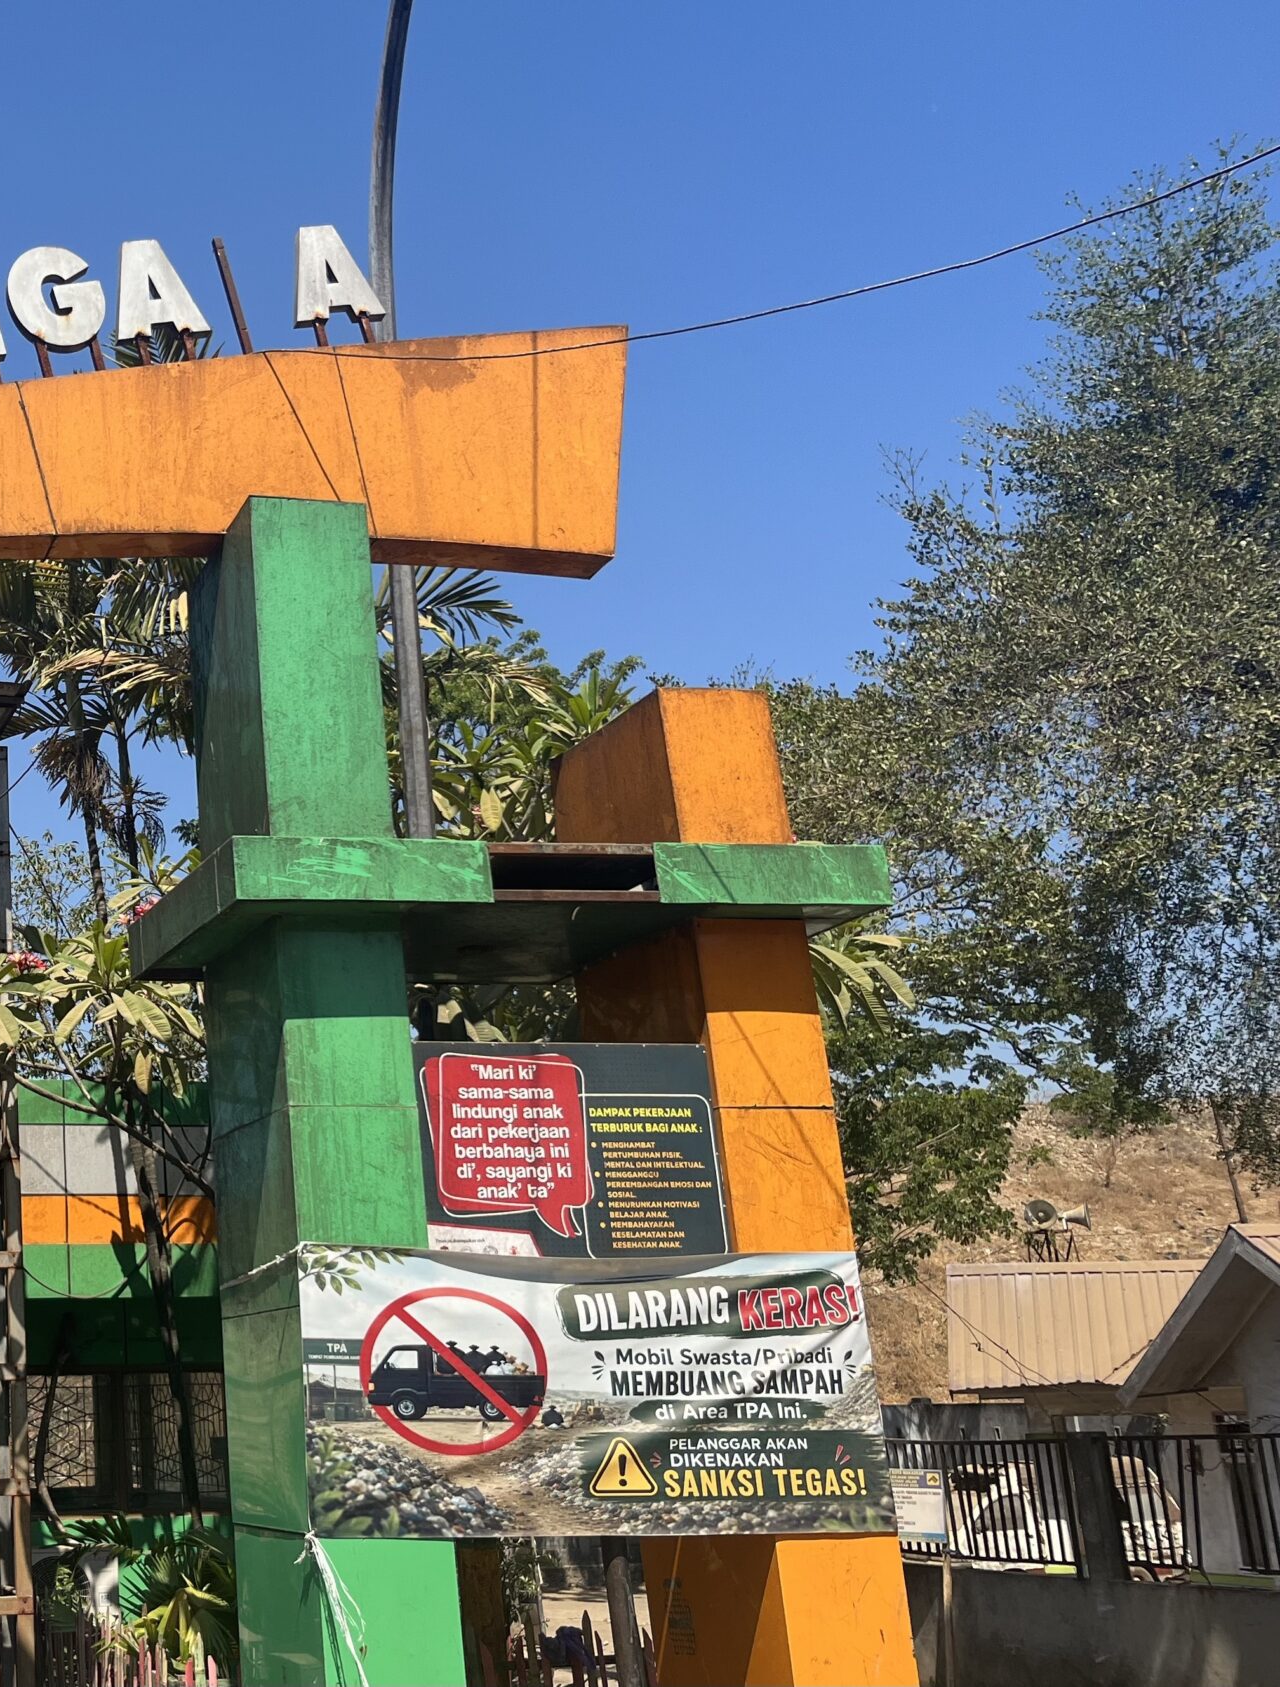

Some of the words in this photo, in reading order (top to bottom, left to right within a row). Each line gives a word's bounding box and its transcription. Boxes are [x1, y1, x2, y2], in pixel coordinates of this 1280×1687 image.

[458, 1086, 554, 1100] sama-sama
[452, 1103, 517, 1123] lindungi
[521, 1104, 563, 1119] anak
[589, 1108, 631, 1118] DAMPAK
[633, 1108, 692, 1118] PEKERJAAN
[450, 1123, 483, 1139] dari
[487, 1124, 570, 1144] pekerjaan
[590, 1123, 644, 1133] TERBURUK
[645, 1123, 669, 1133] BAGI
[601, 1141, 656, 1149] MENGHAMBAT
[455, 1144, 545, 1164] berbahaya
[549, 1144, 570, 1159] ini
[602, 1151, 661, 1159] PERTUMBUHAN
[604, 1161, 634, 1169] MENTAL
[485, 1164, 553, 1184] sayangi
[556, 1164, 572, 1178] ki
[608, 1201, 663, 1209] MENURUNKAN
[663, 1201, 700, 1209] MOTIVASI
[609, 1211, 645, 1219] BELAJAR
[610, 1221, 675, 1229] MEMBAHAYAKAN
[611, 1231, 668, 1239] KESELAMATAN
[668, 1231, 685, 1239] DAN
[612, 1241, 657, 1249] KESEHATAN
[573, 1285, 730, 1333] DILARANG
[737, 1285, 860, 1332] KERAS!
[326, 1343, 348, 1353] TPA
[616, 1348, 674, 1366] Mobil
[680, 1347, 833, 1366] Swasta/Pribadi
[609, 1369, 746, 1397] MEMBUANG
[753, 1369, 844, 1396] SAMPAH
[655, 1403, 673, 1420] di
[683, 1403, 728, 1420] Area
[734, 1402, 771, 1419] TPA
[778, 1402, 807, 1419] Ini.
[669, 1438, 763, 1450] PELANGGAR
[766, 1437, 808, 1449] AKAN
[670, 1453, 784, 1468] DIKENAKAN
[663, 1469, 764, 1497] SANKSI
[773, 1468, 868, 1496] TEGAS!
